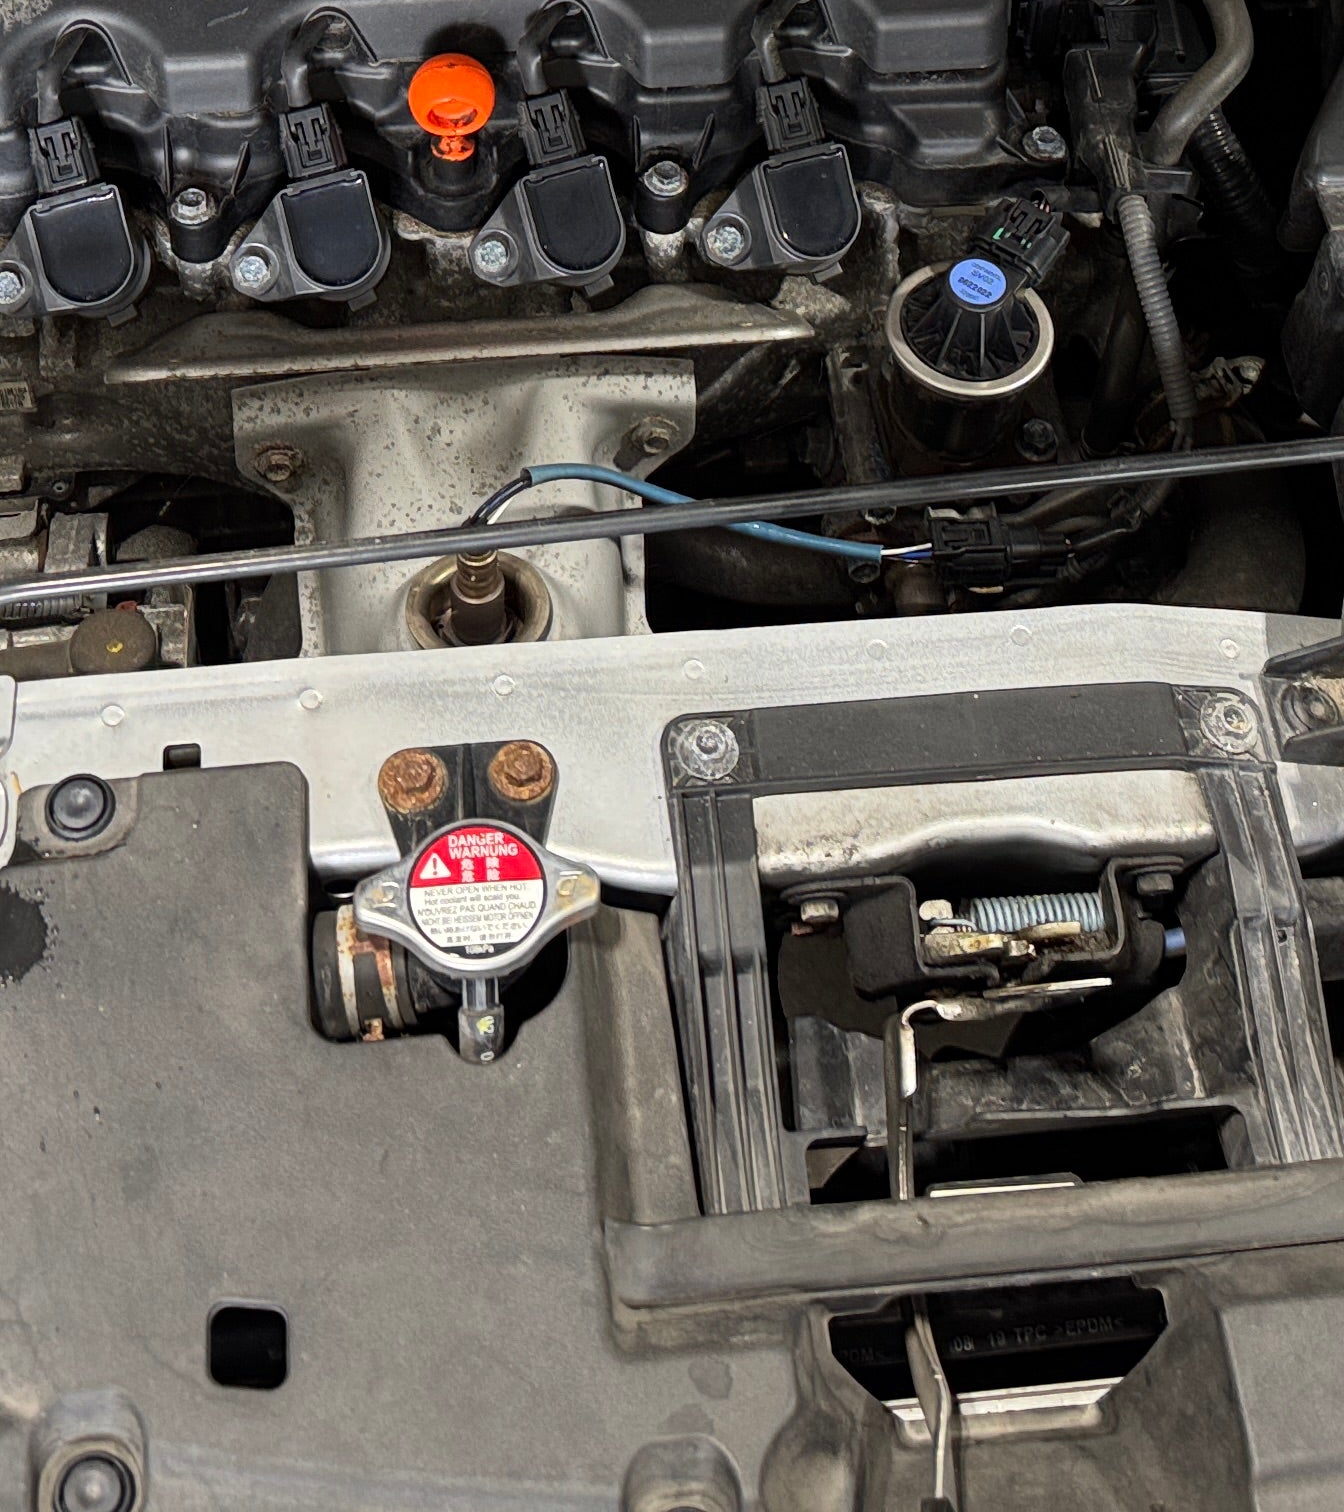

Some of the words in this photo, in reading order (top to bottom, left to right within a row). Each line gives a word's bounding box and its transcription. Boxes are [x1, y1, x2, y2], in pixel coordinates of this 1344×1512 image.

[447, 832, 505, 848] DANGER
[448, 843, 519, 859] WARNUNG
[424, 888, 454, 897] NEVER
[455, 886, 480, 894] OPEN
[481, 884, 508, 892] WHEN
[424, 898, 439, 906] Hot
[439, 896, 467, 905] coolant
[469, 894, 482, 902] will
[483, 893, 504, 902] scald
[417, 905, 458, 917] N'OUVREZ
[459, 904, 476, 913] PAS
[477, 902, 506, 912] QUAND
[421, 917, 441, 926] NICHT
[483, 912, 507, 922] MOTOR
